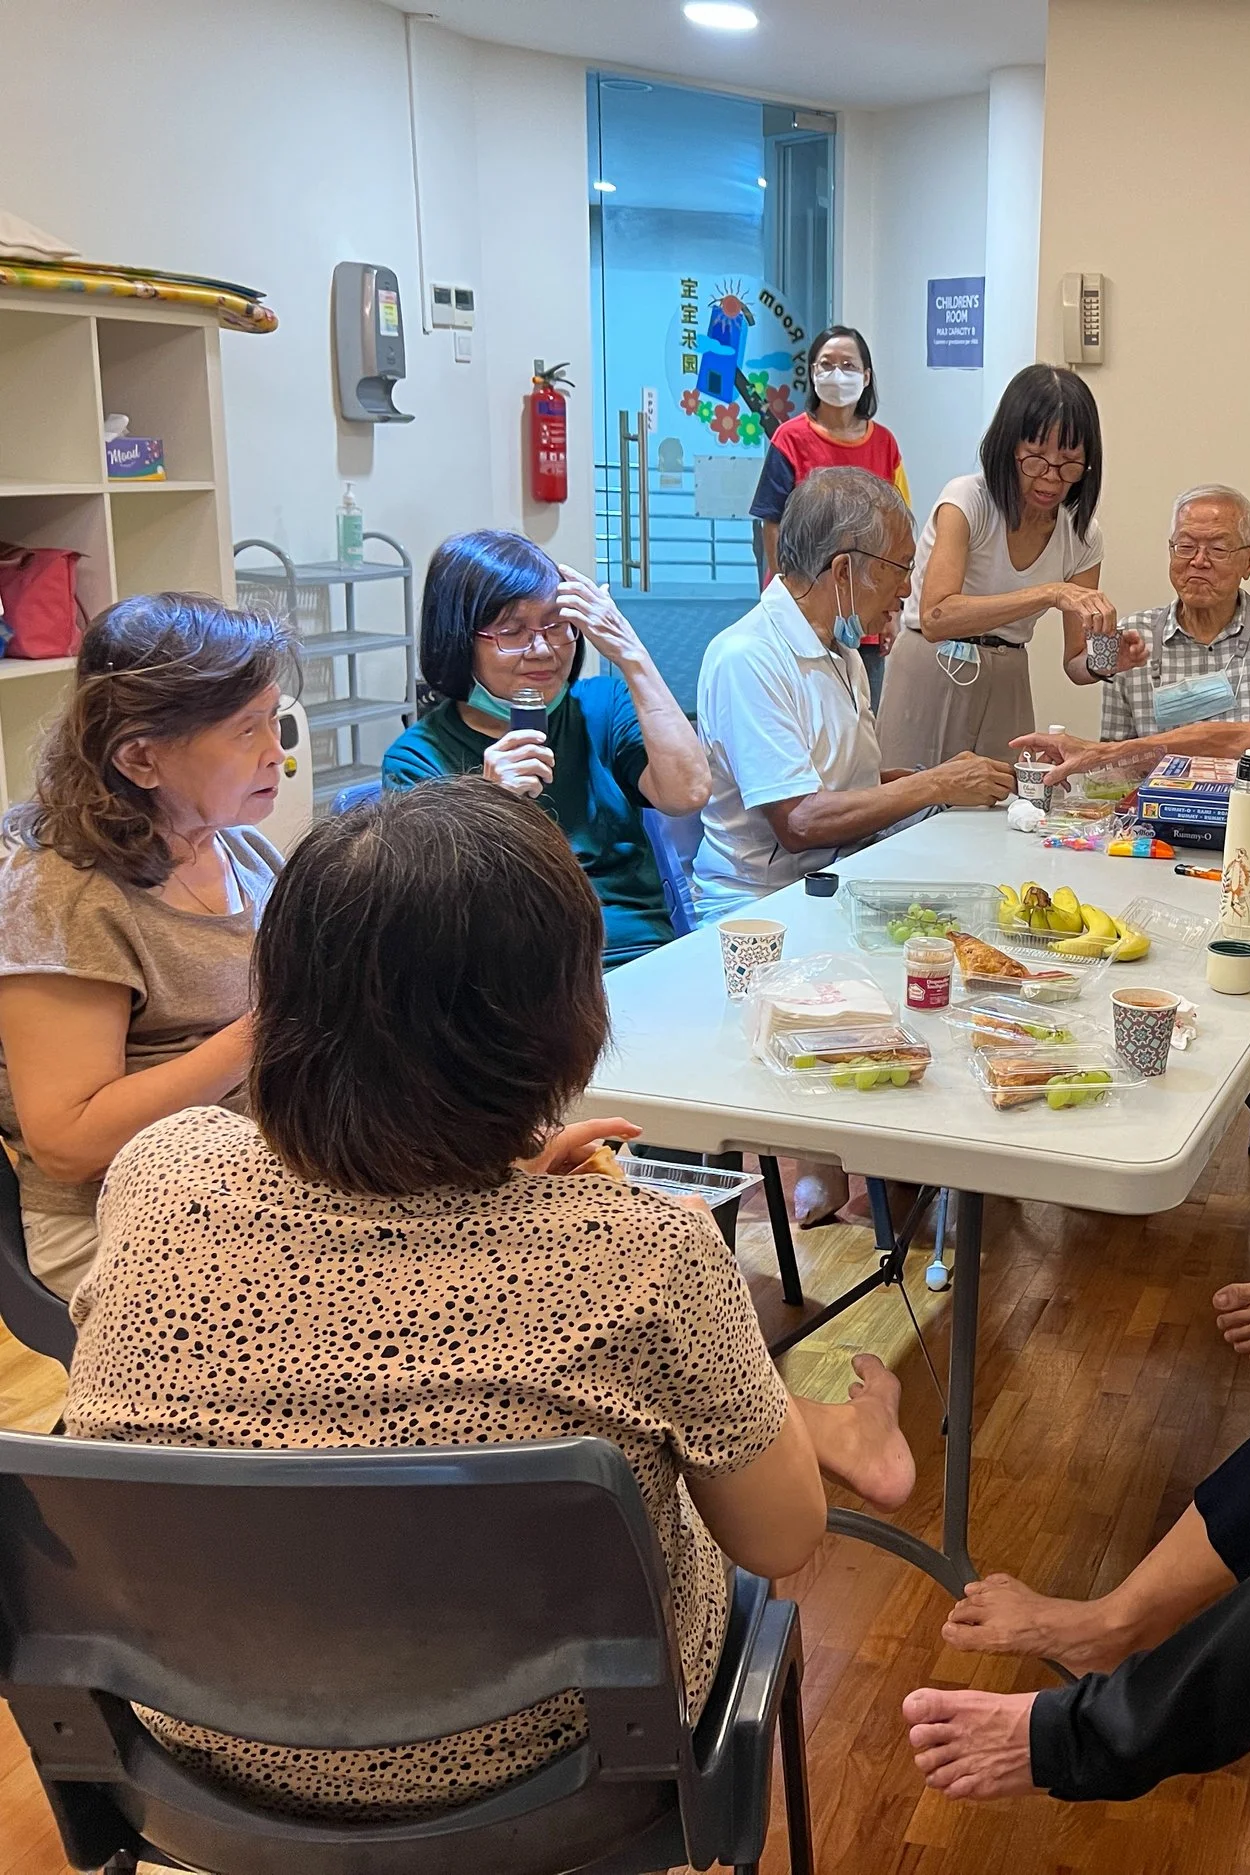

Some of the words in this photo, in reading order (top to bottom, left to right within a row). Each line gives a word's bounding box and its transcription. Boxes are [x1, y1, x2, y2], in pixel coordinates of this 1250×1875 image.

[935, 294, 980, 310] CHILDREN'S
[945, 309, 968, 323] ROOM
[107, 444, 140, 465] Mood
[1173, 829, 1212, 842] Rummy-O
